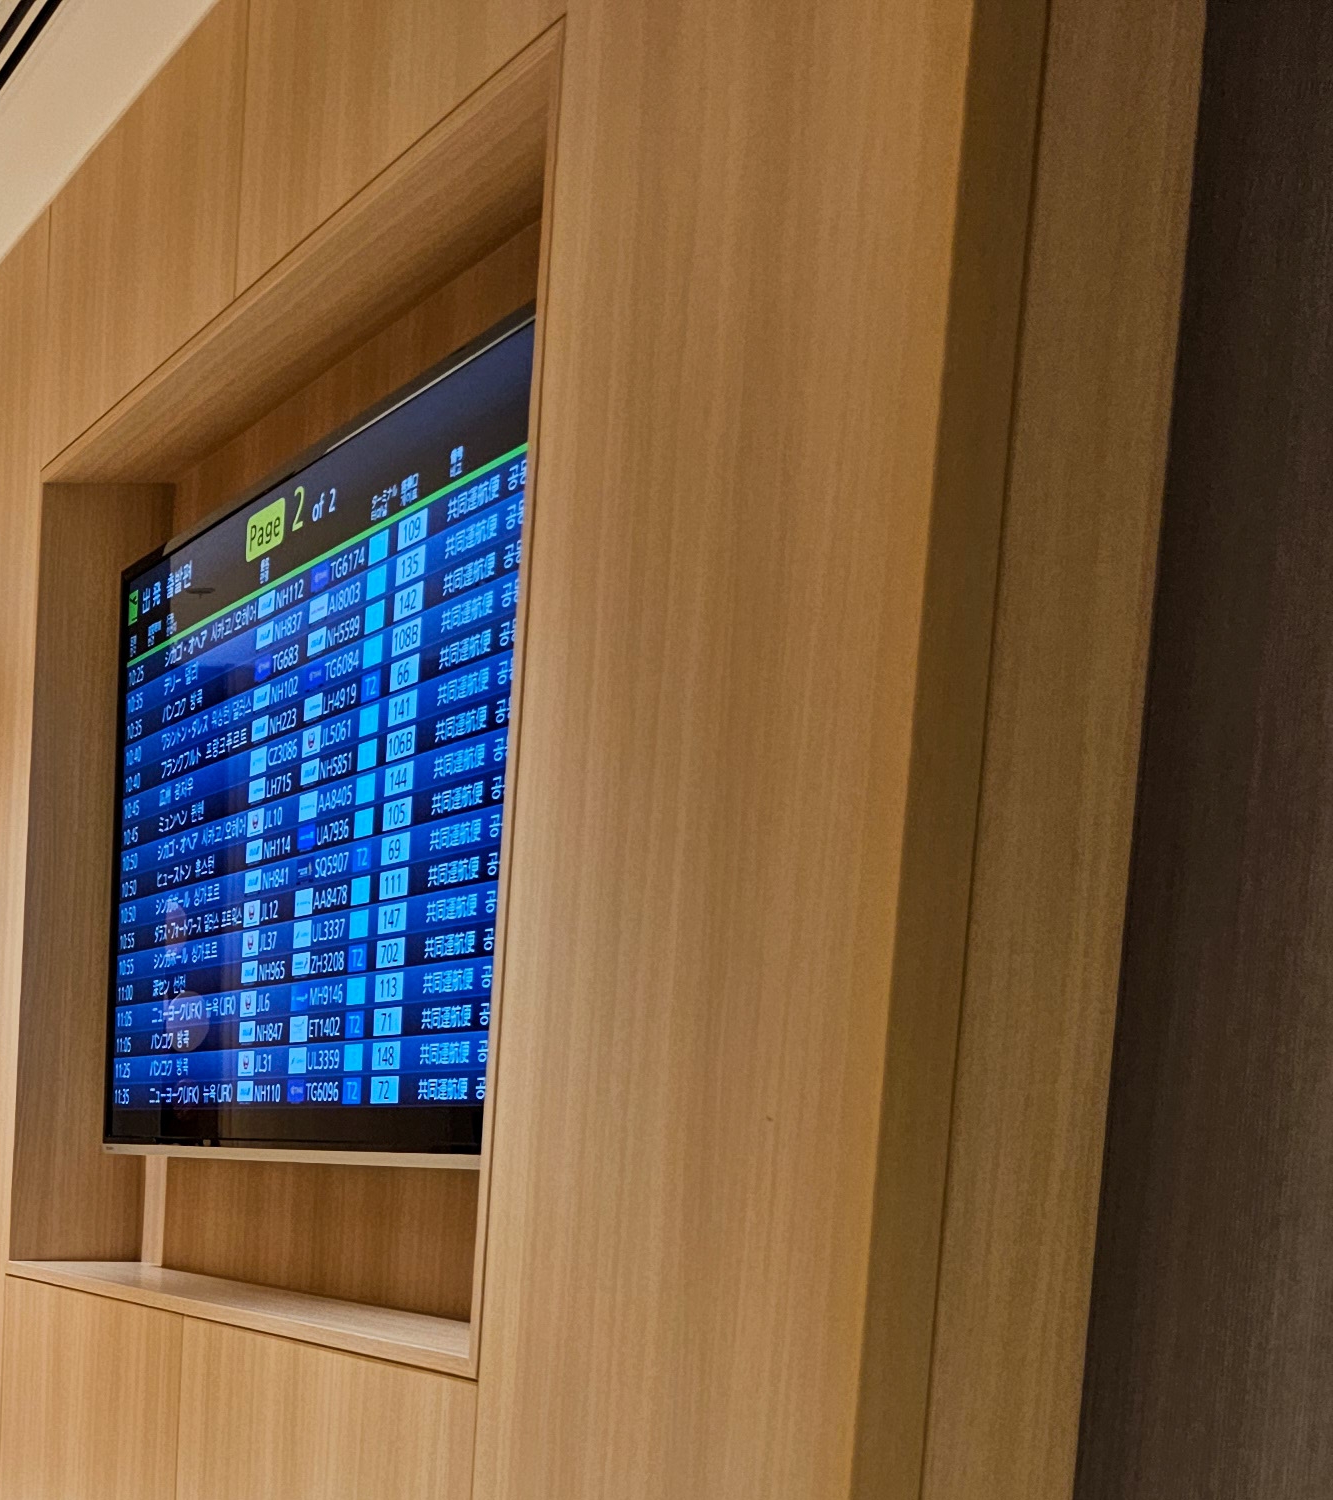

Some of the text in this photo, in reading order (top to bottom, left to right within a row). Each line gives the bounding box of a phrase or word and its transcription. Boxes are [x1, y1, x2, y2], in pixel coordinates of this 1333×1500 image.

[249, 486, 337, 552] Page 2 of 2
[403, 515, 421, 545] 109
[329, 545, 365, 583] TG6174
[401, 552, 418, 581] 135
[275, 577, 304, 612] NH112
[328, 581, 361, 617] AI8003
[399, 588, 416, 617] 142
[273, 611, 302, 644] NH837
[326, 616, 360, 651] NH5599
[393, 623, 418, 655] 108B
[272, 644, 299, 676] TG683
[323, 650, 359, 685] TG6084
[363, 675, 377, 700] T2
[396, 662, 410, 688] 66
[270, 676, 298, 707] NH102
[322, 685, 356, 718] LH4919
[268, 709, 296, 739] NH223
[392, 698, 410, 725] 141
[320, 720, 351, 751] JL5061
[387, 732, 412, 761] 106B
[267, 740, 297, 770] CZ3086
[319, 753, 352, 784] NH5851
[265, 774, 291, 801] LH715
[389, 769, 407, 795] 144
[317, 786, 352, 816] AA8405
[264, 808, 282, 832] JL10
[387, 804, 405, 829] 105
[315, 821, 349, 849] UA7936
[263, 837, 291, 863] NH114
[355, 848, 368, 869] T2
[388, 840, 401, 863] 69
[314, 854, 349, 881] SQ5907
[261, 868, 289, 893] NH841
[384, 875, 401, 898] 111
[312, 887, 347, 913] AA8478
[260, 902, 278, 924] JL12
[382, 909, 400, 932] 147
[259, 933, 277, 954] JL37
[311, 920, 345, 945] UL3337
[310, 953, 344, 977] ZH3208
[350, 949, 363, 969] T2
[380, 944, 398, 966] 702
[258, 962, 285, 984] NH965
[309, 985, 343, 1008] MH9146
[379, 978, 397, 1000] 113
[256, 994, 270, 1014] JL6
[255, 1023, 283, 1044] NH847
[308, 1018, 340, 1039] ET1402
[348, 1015, 360, 1034] T2
[380, 1013, 392, 1033] 71
[254, 1054, 272, 1073] JL31
[307, 1050, 339, 1071] UL3359
[377, 1046, 394, 1067] 148
[253, 1084, 281, 1103] NH110
[305, 1082, 339, 1102] TG6096
[346, 1081, 358, 1099] T2
[377, 1080, 390, 1100] 72
